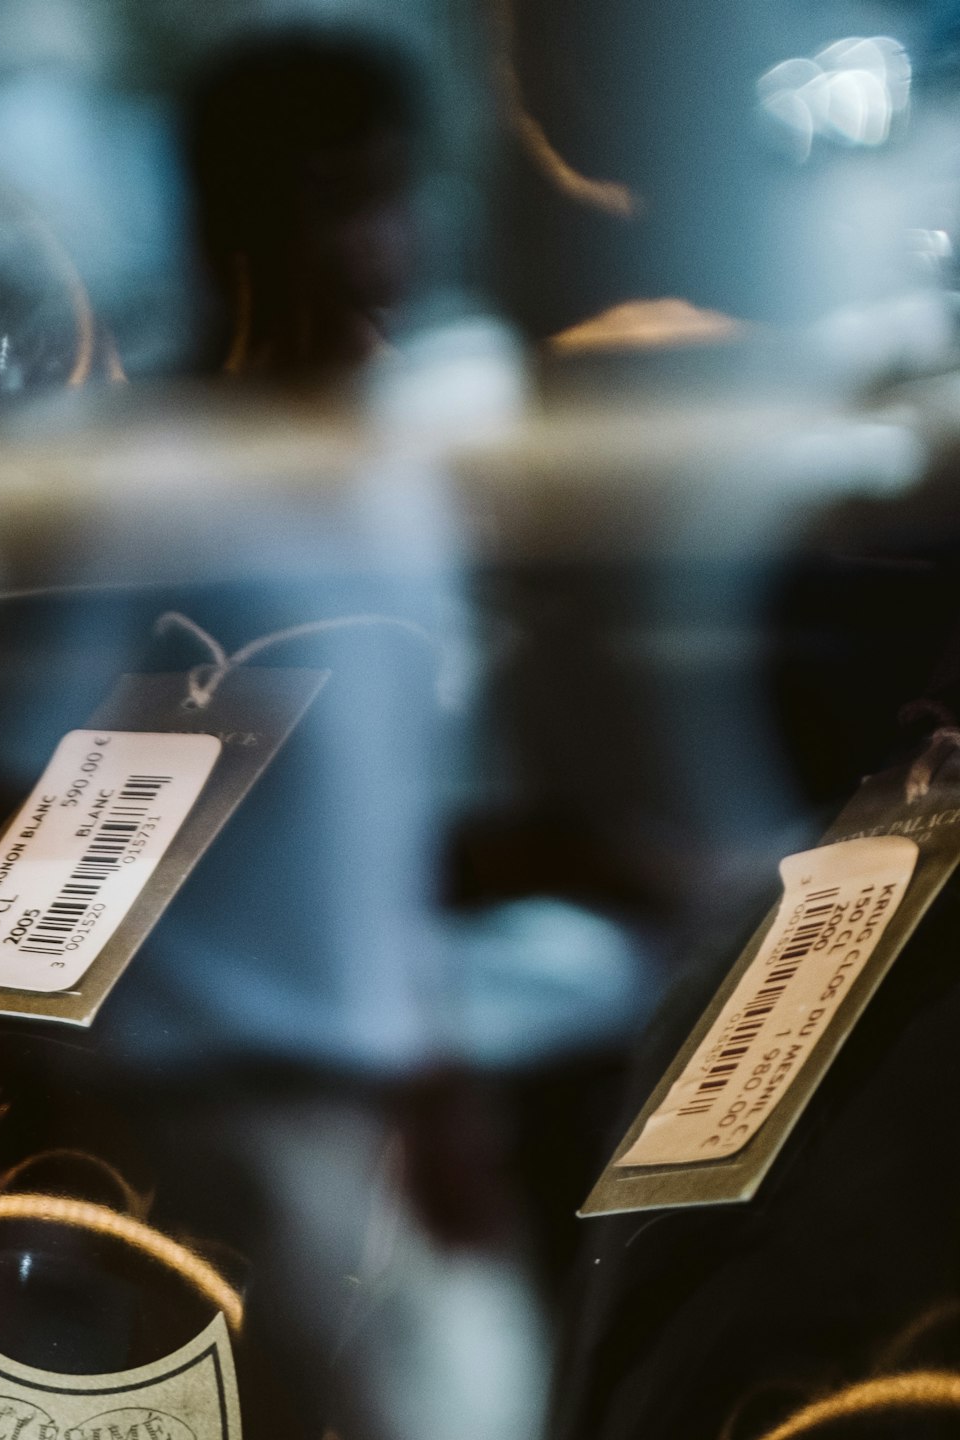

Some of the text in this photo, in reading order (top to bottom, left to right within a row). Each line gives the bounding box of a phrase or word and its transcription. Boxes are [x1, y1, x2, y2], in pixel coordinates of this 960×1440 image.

[60, 752, 104, 807] 590.00
[20, 795, 56, 838] BLANC
[75, 788, 115, 837] BLANC
[50, 815, 161, 969] 3 001520 015731
[856, 883, 896, 943] KRUG
[3, 908, 41, 945] 2005
[813, 901, 849, 951] 2000
[827, 883, 874, 956] 150 CL
[820, 949, 860, 1001] CLOS
[799, 1006, 826, 1036] DU
[718, 1048, 781, 1128] 980.00
[744, 1044, 803, 1119] MESNIL
